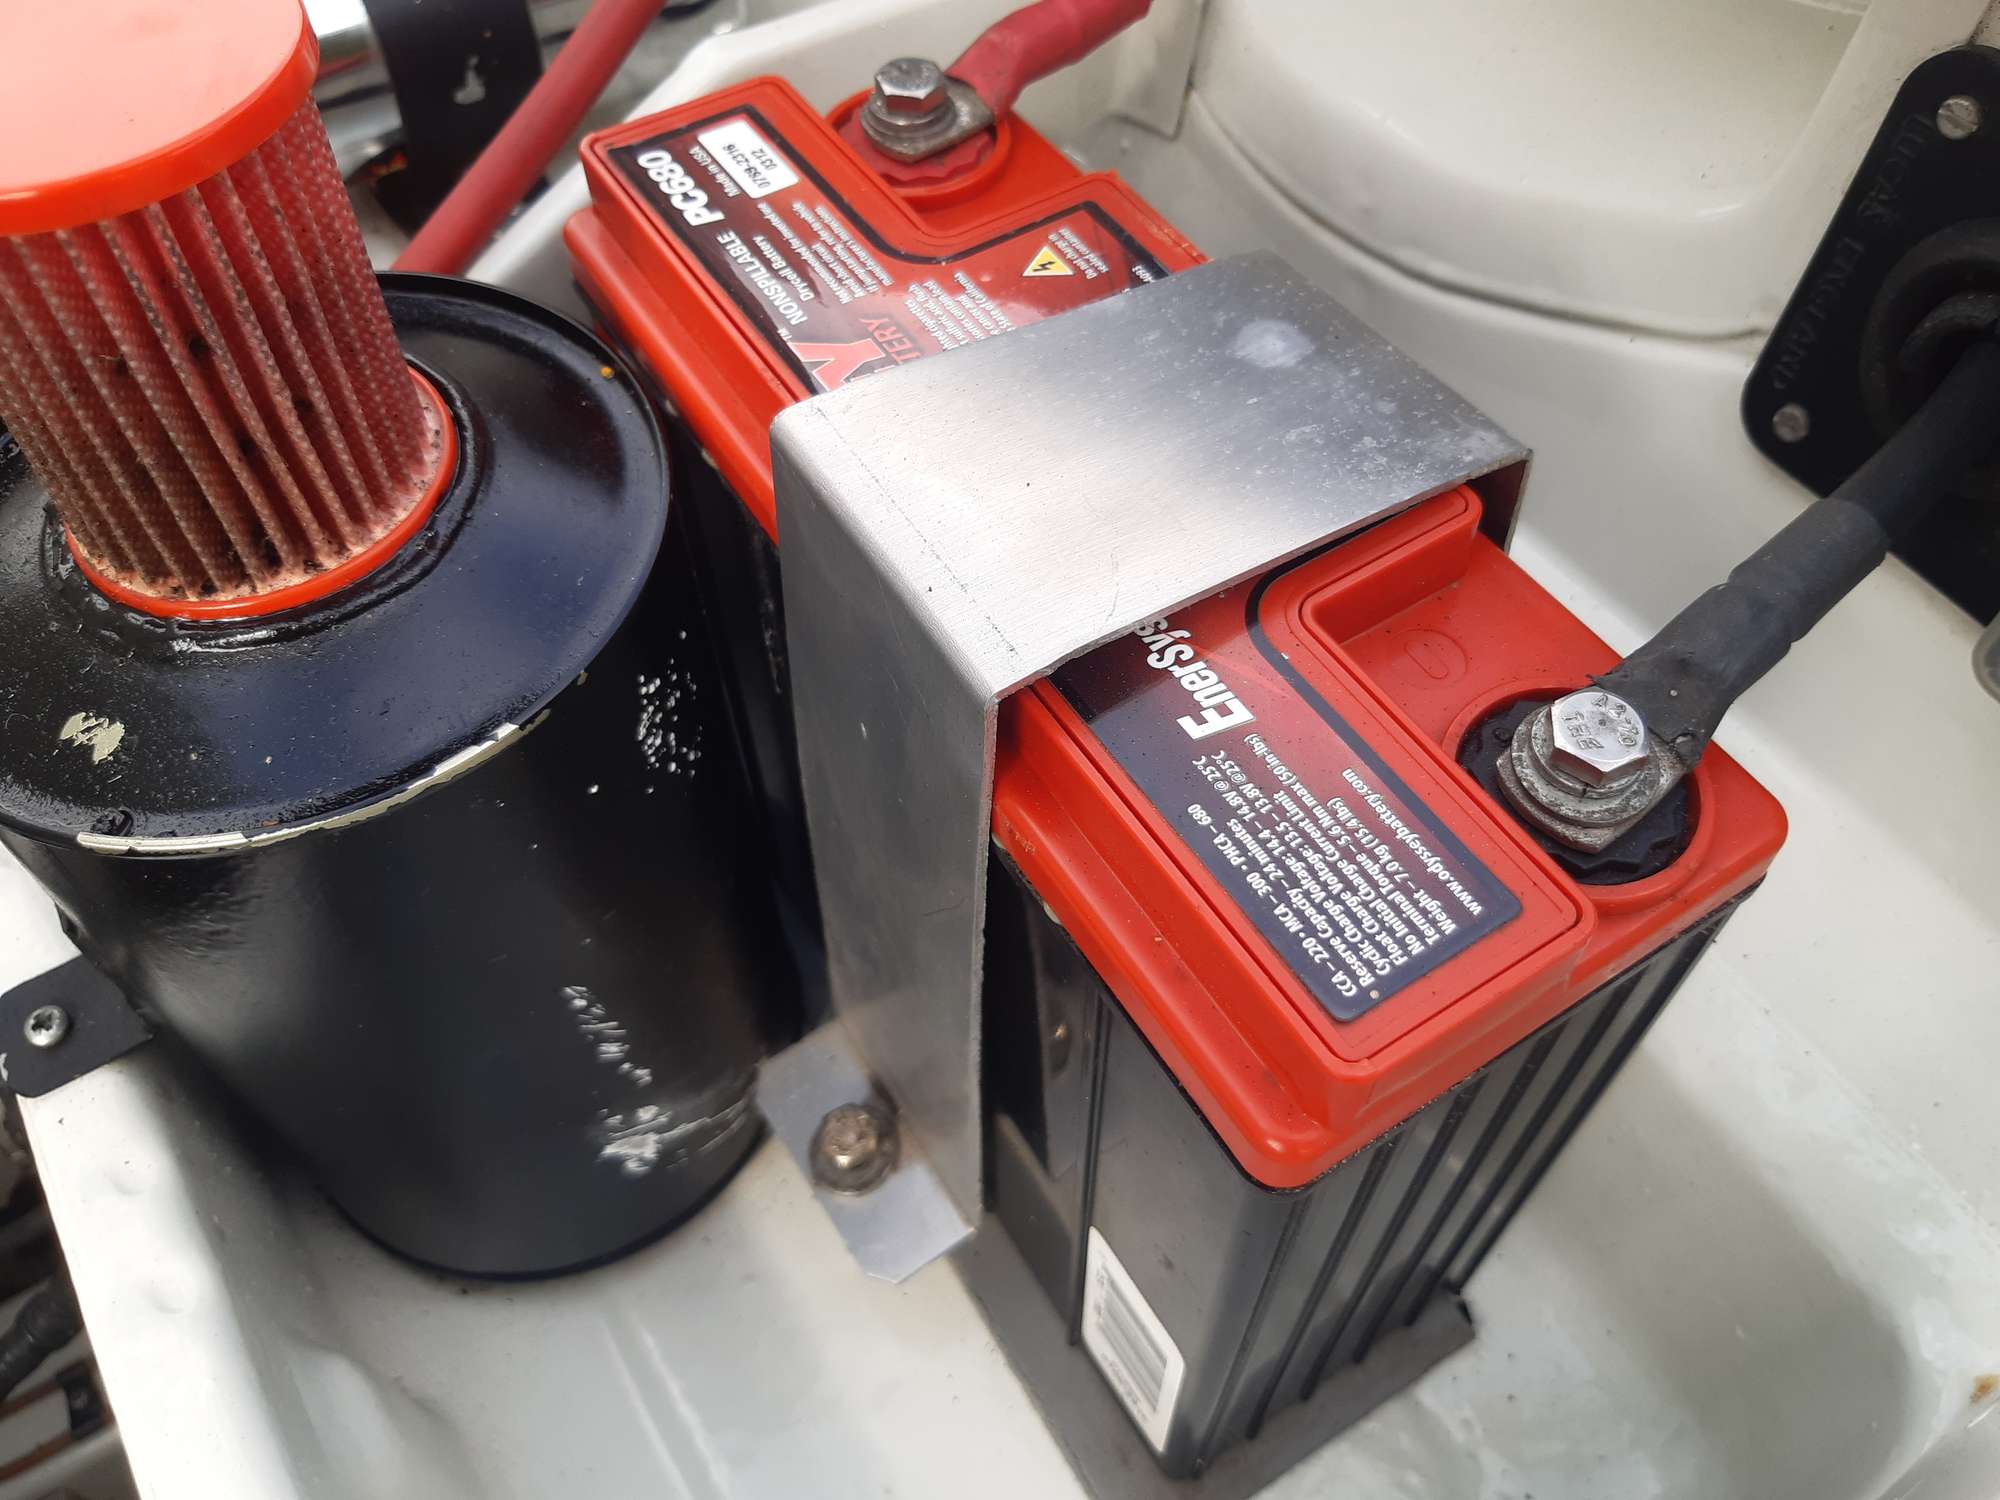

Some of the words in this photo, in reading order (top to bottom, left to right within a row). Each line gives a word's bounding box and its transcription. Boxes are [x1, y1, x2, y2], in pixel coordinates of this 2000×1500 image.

[690, 146, 711, 165] USA
[708, 164, 720, 173] in
[638, 151, 724, 226] PC680
[716, 173, 740, 196] Made
[754, 236, 786, 269] Battery
[718, 232, 808, 324] NONSPILLABLE
[779, 268, 814, 302] Drycell
[1773, 236, 1864, 391] ENGLAND
[1134, 617, 1256, 741] EnerSys
[1244, 734, 1282, 768] in-lbs)
[1272, 766, 1296, 784] (50
[1222, 791, 1255, 821] 14.8V
[1239, 784, 1272, 814] 13.8V
[1274, 790, 1304, 821] Limit
[1291, 782, 1317, 807] max
[1327, 798, 1354, 820] lbs)
[1188, 804, 1212, 825] 680
[1313, 806, 1335, 827] Nm
[1227, 819, 1270, 865] minutes
[1258, 830, 1285, 855] 14.4
[1275, 822, 1302, 847] 13.5
[1298, 818, 1340, 861] Current
[1328, 826, 1350, 845] 5.6
[1342, 769, 1482, 915] www.odysseybattery.com
[1344, 818, 1378, 847] (15.4
[1214, 833, 1245, 865] PHCA
[1374, 845, 1392, 864] kg
[1246, 872, 1272, 896] 300
[1263, 863, 1284, 880] 24
[1282, 853, 1326, 903] Voltage:
[1299, 845, 1343, 894] Voltage:
[1337, 859, 1375, 900] Charge
[1356, 853, 1394, 894] Torque
[1386, 862, 1408, 882] 7.0
[1274, 903, 1303, 932] MCA
[1286, 889, 1332, 938] Capacity
[1323, 900, 1362, 942] Charge
[1340, 891, 1379, 933] Charge
[1369, 899, 1408, 937] Initial
[1387, 891, 1440, 945] Terminal
[1413, 889, 1456, 934] Weight
[1302, 938, 1329, 963] 220
[1330, 936, 1375, 986] Reserve
[1358, 940, 1390, 975] Cyclic
[1375, 931, 1408, 965] Float
[1405, 935, 1424, 955] No
[1332, 971, 1357, 996] CCA
